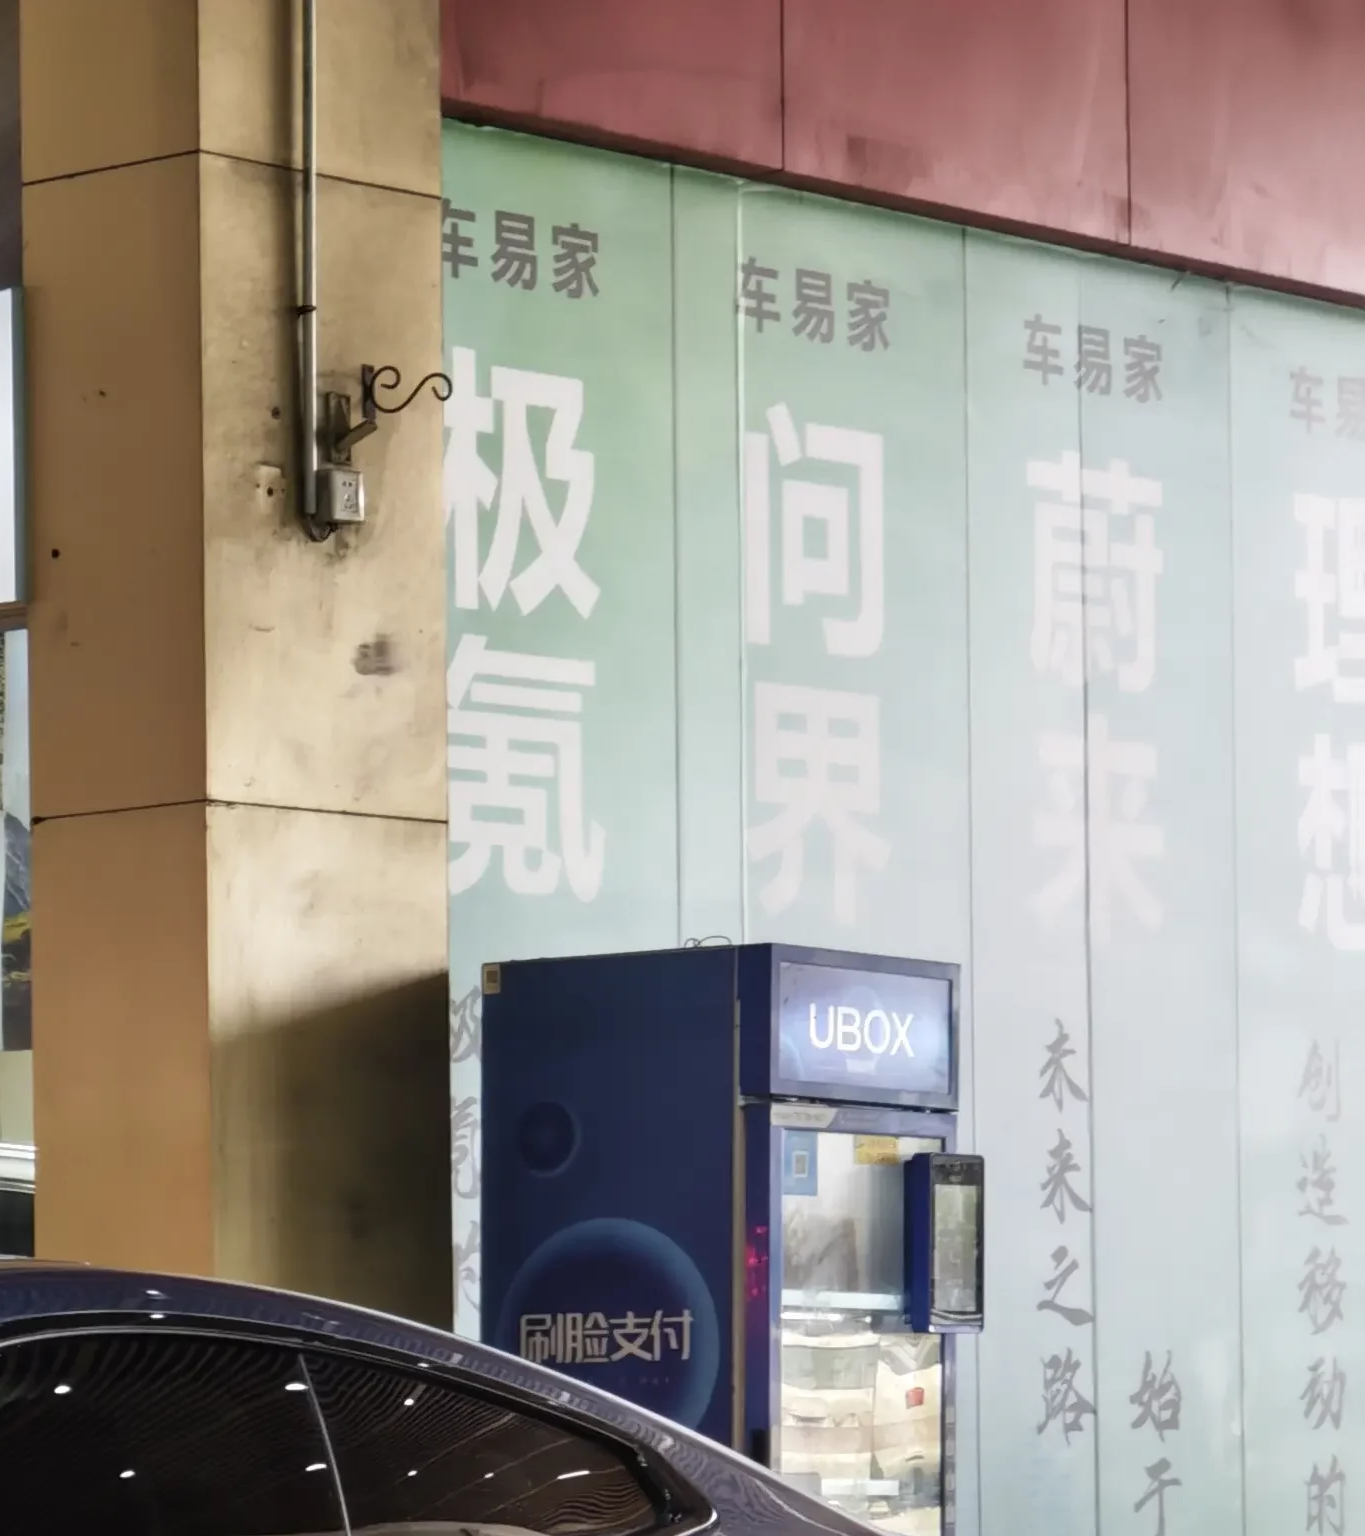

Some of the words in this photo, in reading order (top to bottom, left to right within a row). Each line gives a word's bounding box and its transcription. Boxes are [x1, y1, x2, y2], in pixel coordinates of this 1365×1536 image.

[735, 256, 891, 353] 车易家
[1023, 313, 1165, 404] 车易家
[441, 346, 606, 902] 极氪
[743, 403, 892, 927] 问界
[1026, 450, 1167, 944] 蔚来
[809, 1002, 915, 1058] UBOX
[519, 1308, 694, 1365] 刷脸支付
[1035, 1016, 1098, 1446] 未来之路
